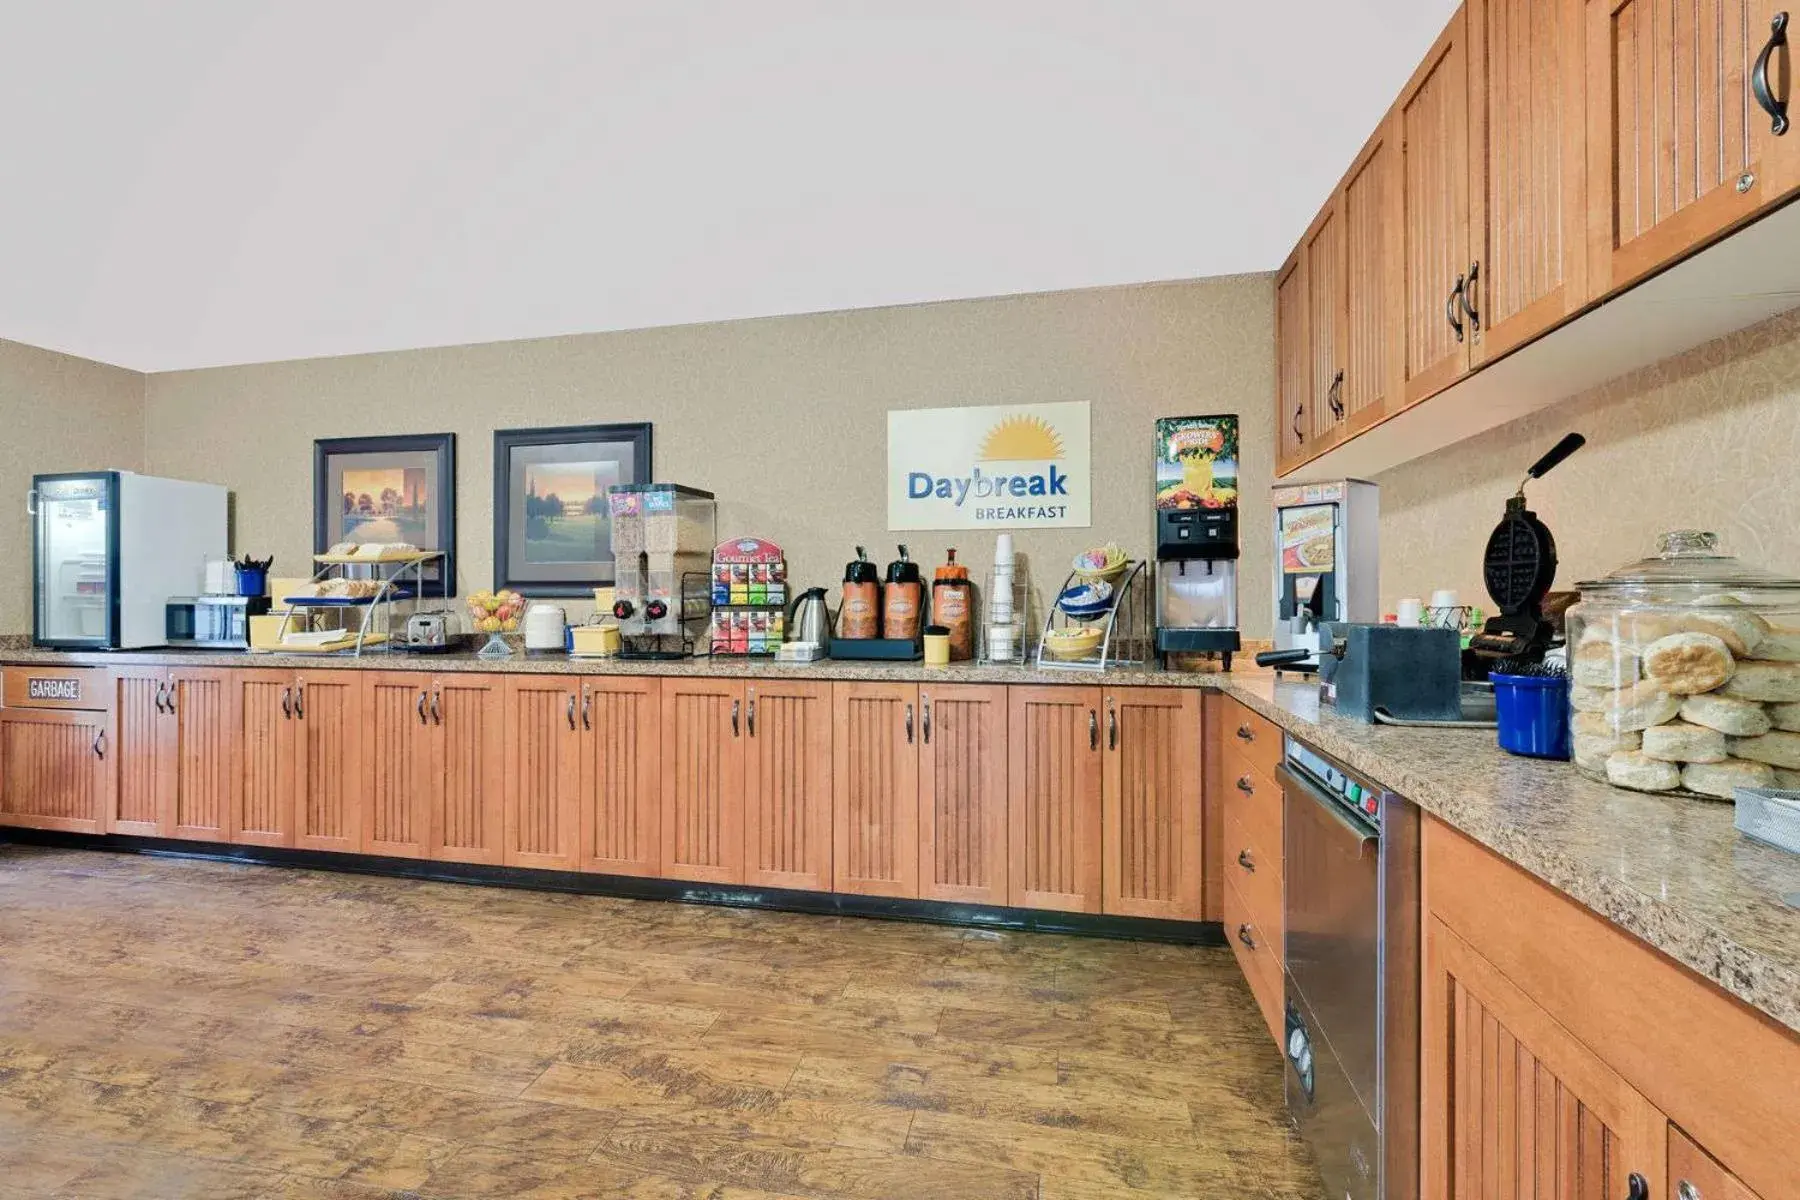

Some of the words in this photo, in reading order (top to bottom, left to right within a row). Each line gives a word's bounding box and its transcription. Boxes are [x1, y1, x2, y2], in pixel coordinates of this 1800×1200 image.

[908, 465, 1067, 507] Daybreak
[975, 506, 1067, 519] BREAKFAST
[30, 680, 77, 698] GARBAGE
